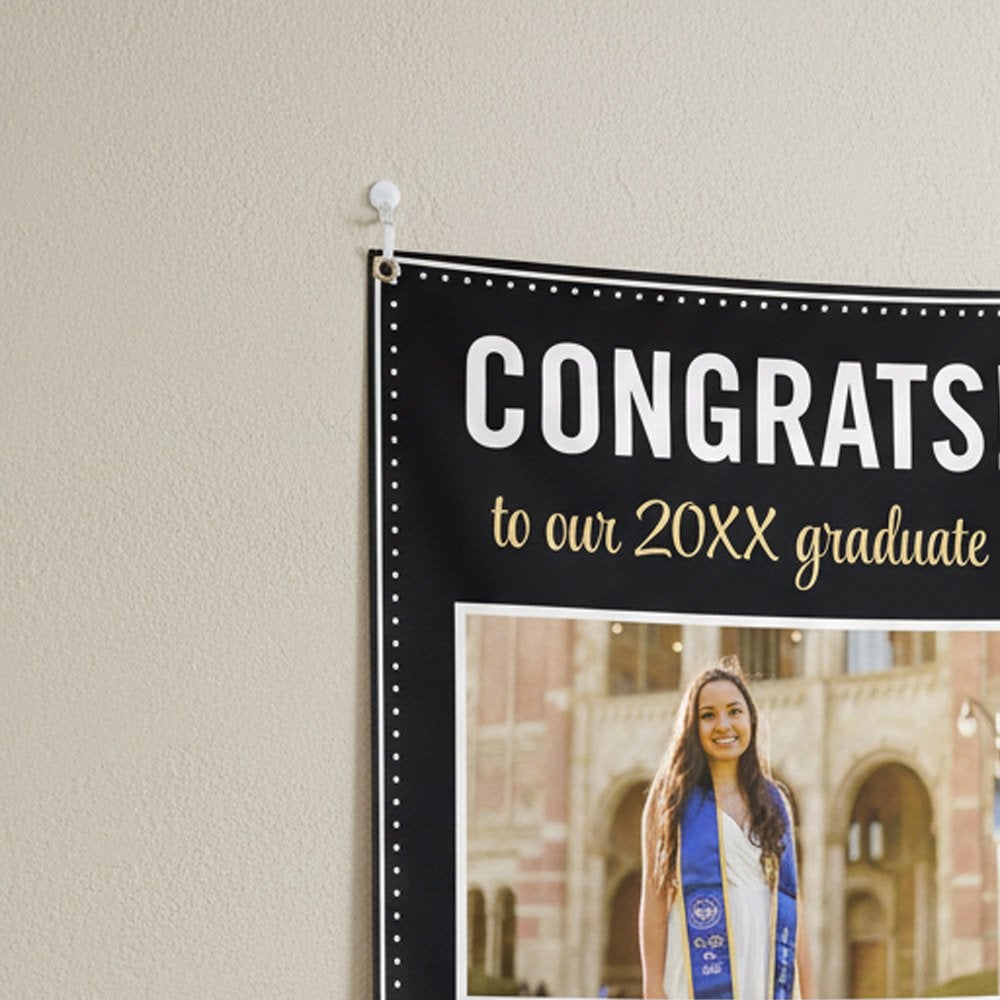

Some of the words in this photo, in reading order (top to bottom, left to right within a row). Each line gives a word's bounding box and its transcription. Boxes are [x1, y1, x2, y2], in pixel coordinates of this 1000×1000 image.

[490, 495, 531, 552] to
[545, 511, 622, 556] our
[634, 498, 780, 563] 20XX
[794, 503, 990, 591] graduate
